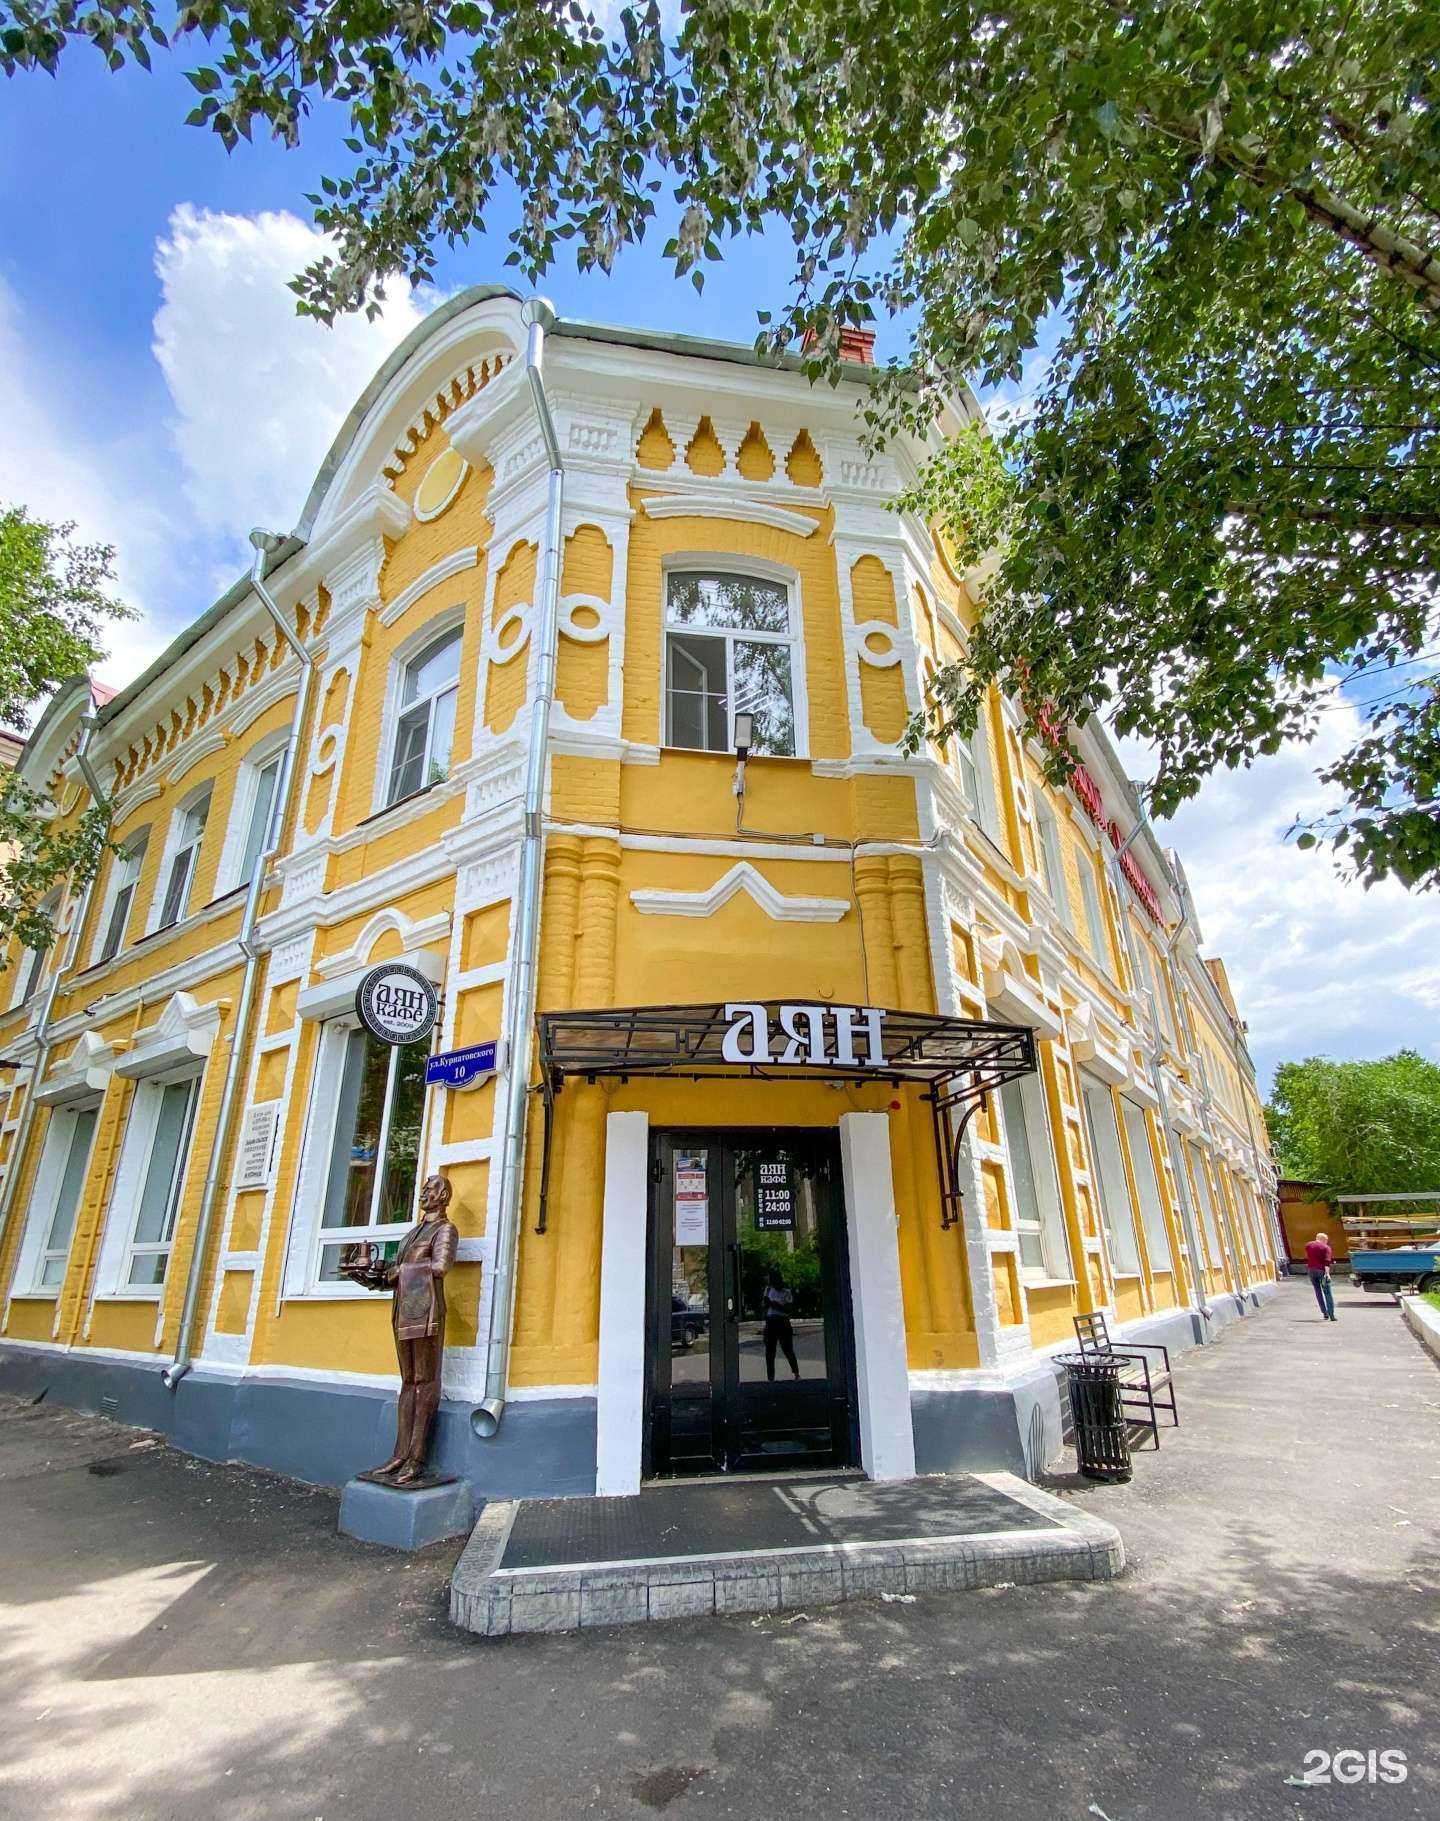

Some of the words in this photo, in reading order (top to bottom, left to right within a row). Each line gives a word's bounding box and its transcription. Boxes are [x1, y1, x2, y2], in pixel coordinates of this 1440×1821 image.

[376, 1003, 423, 1022] кафе
[454, 1066, 466, 1079] 10
[765, 1190, 790, 1200] 11:00
[766, 1202, 791, 1212] 24:00
